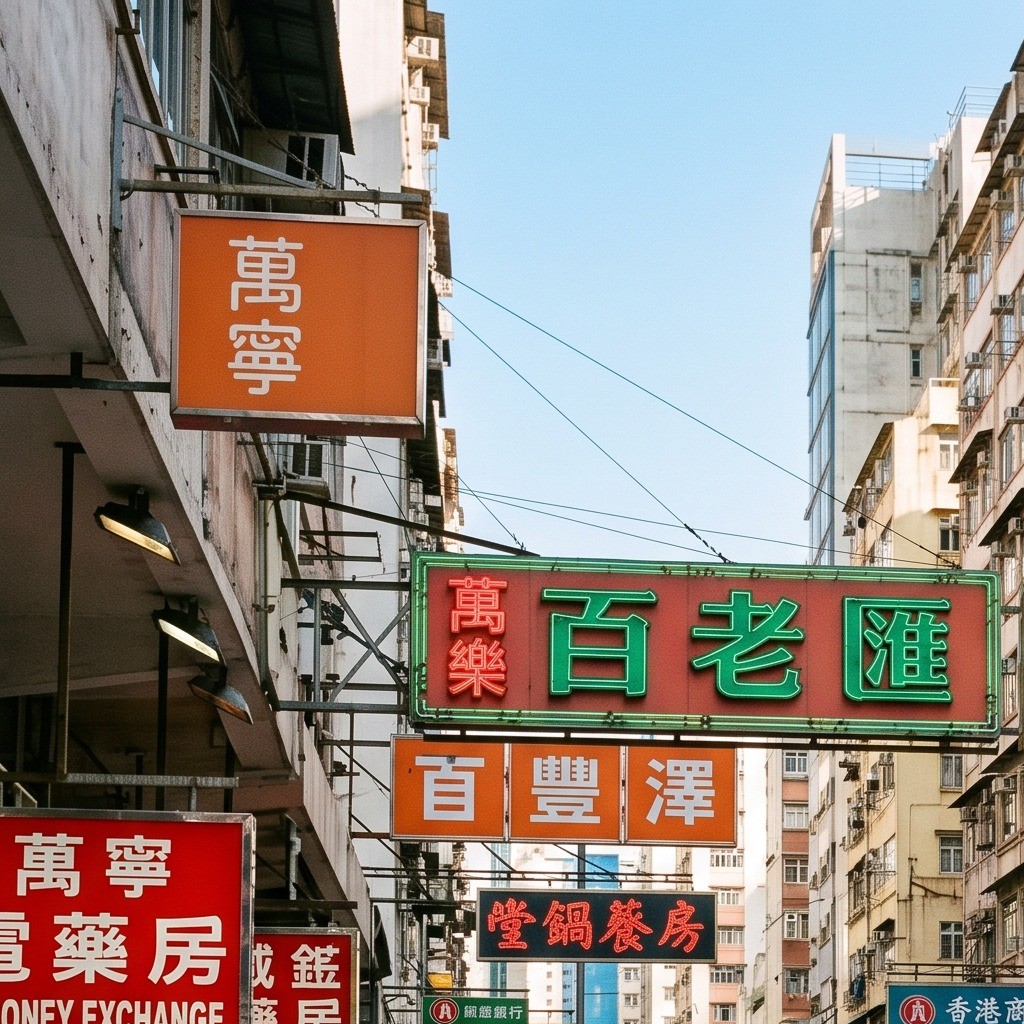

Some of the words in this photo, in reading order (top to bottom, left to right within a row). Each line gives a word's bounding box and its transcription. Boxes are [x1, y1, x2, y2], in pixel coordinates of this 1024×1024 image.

[228, 235, 304, 395] 萬寧
[447, 576, 508, 698] 萬樂
[540, 587, 954, 703] 百老匯
[415, 755, 716, 827] 百豐澤
[15, 832, 172, 898] 萬寧
